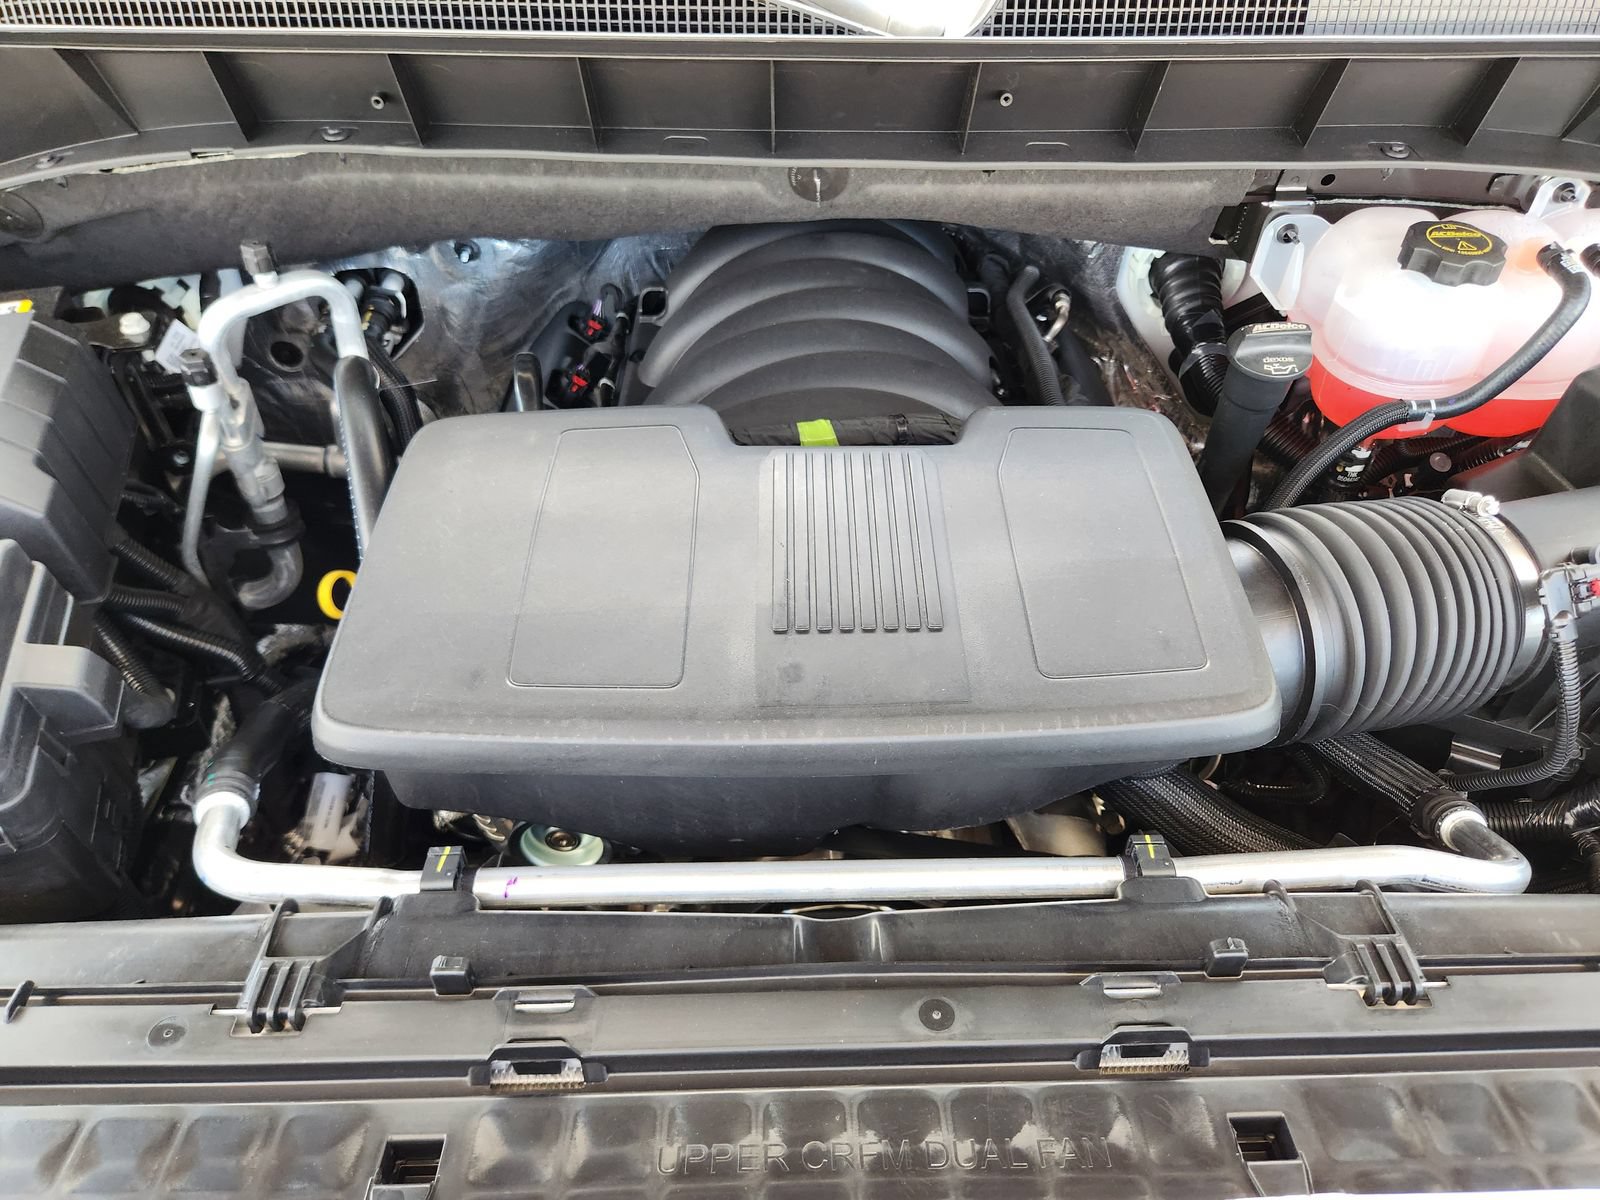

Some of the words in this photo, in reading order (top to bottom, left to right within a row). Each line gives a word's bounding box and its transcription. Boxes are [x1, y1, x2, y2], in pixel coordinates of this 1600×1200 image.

[1430, 231, 1482, 239] ACDelco
[1252, 323, 1307, 333] ACDelco
[656, 1142, 790, 1175] UPPER
[801, 1139, 912, 1172] CRFM
[925, 1138, 1028, 1170] DUAL
[1036, 1137, 1112, 1169] FAN
